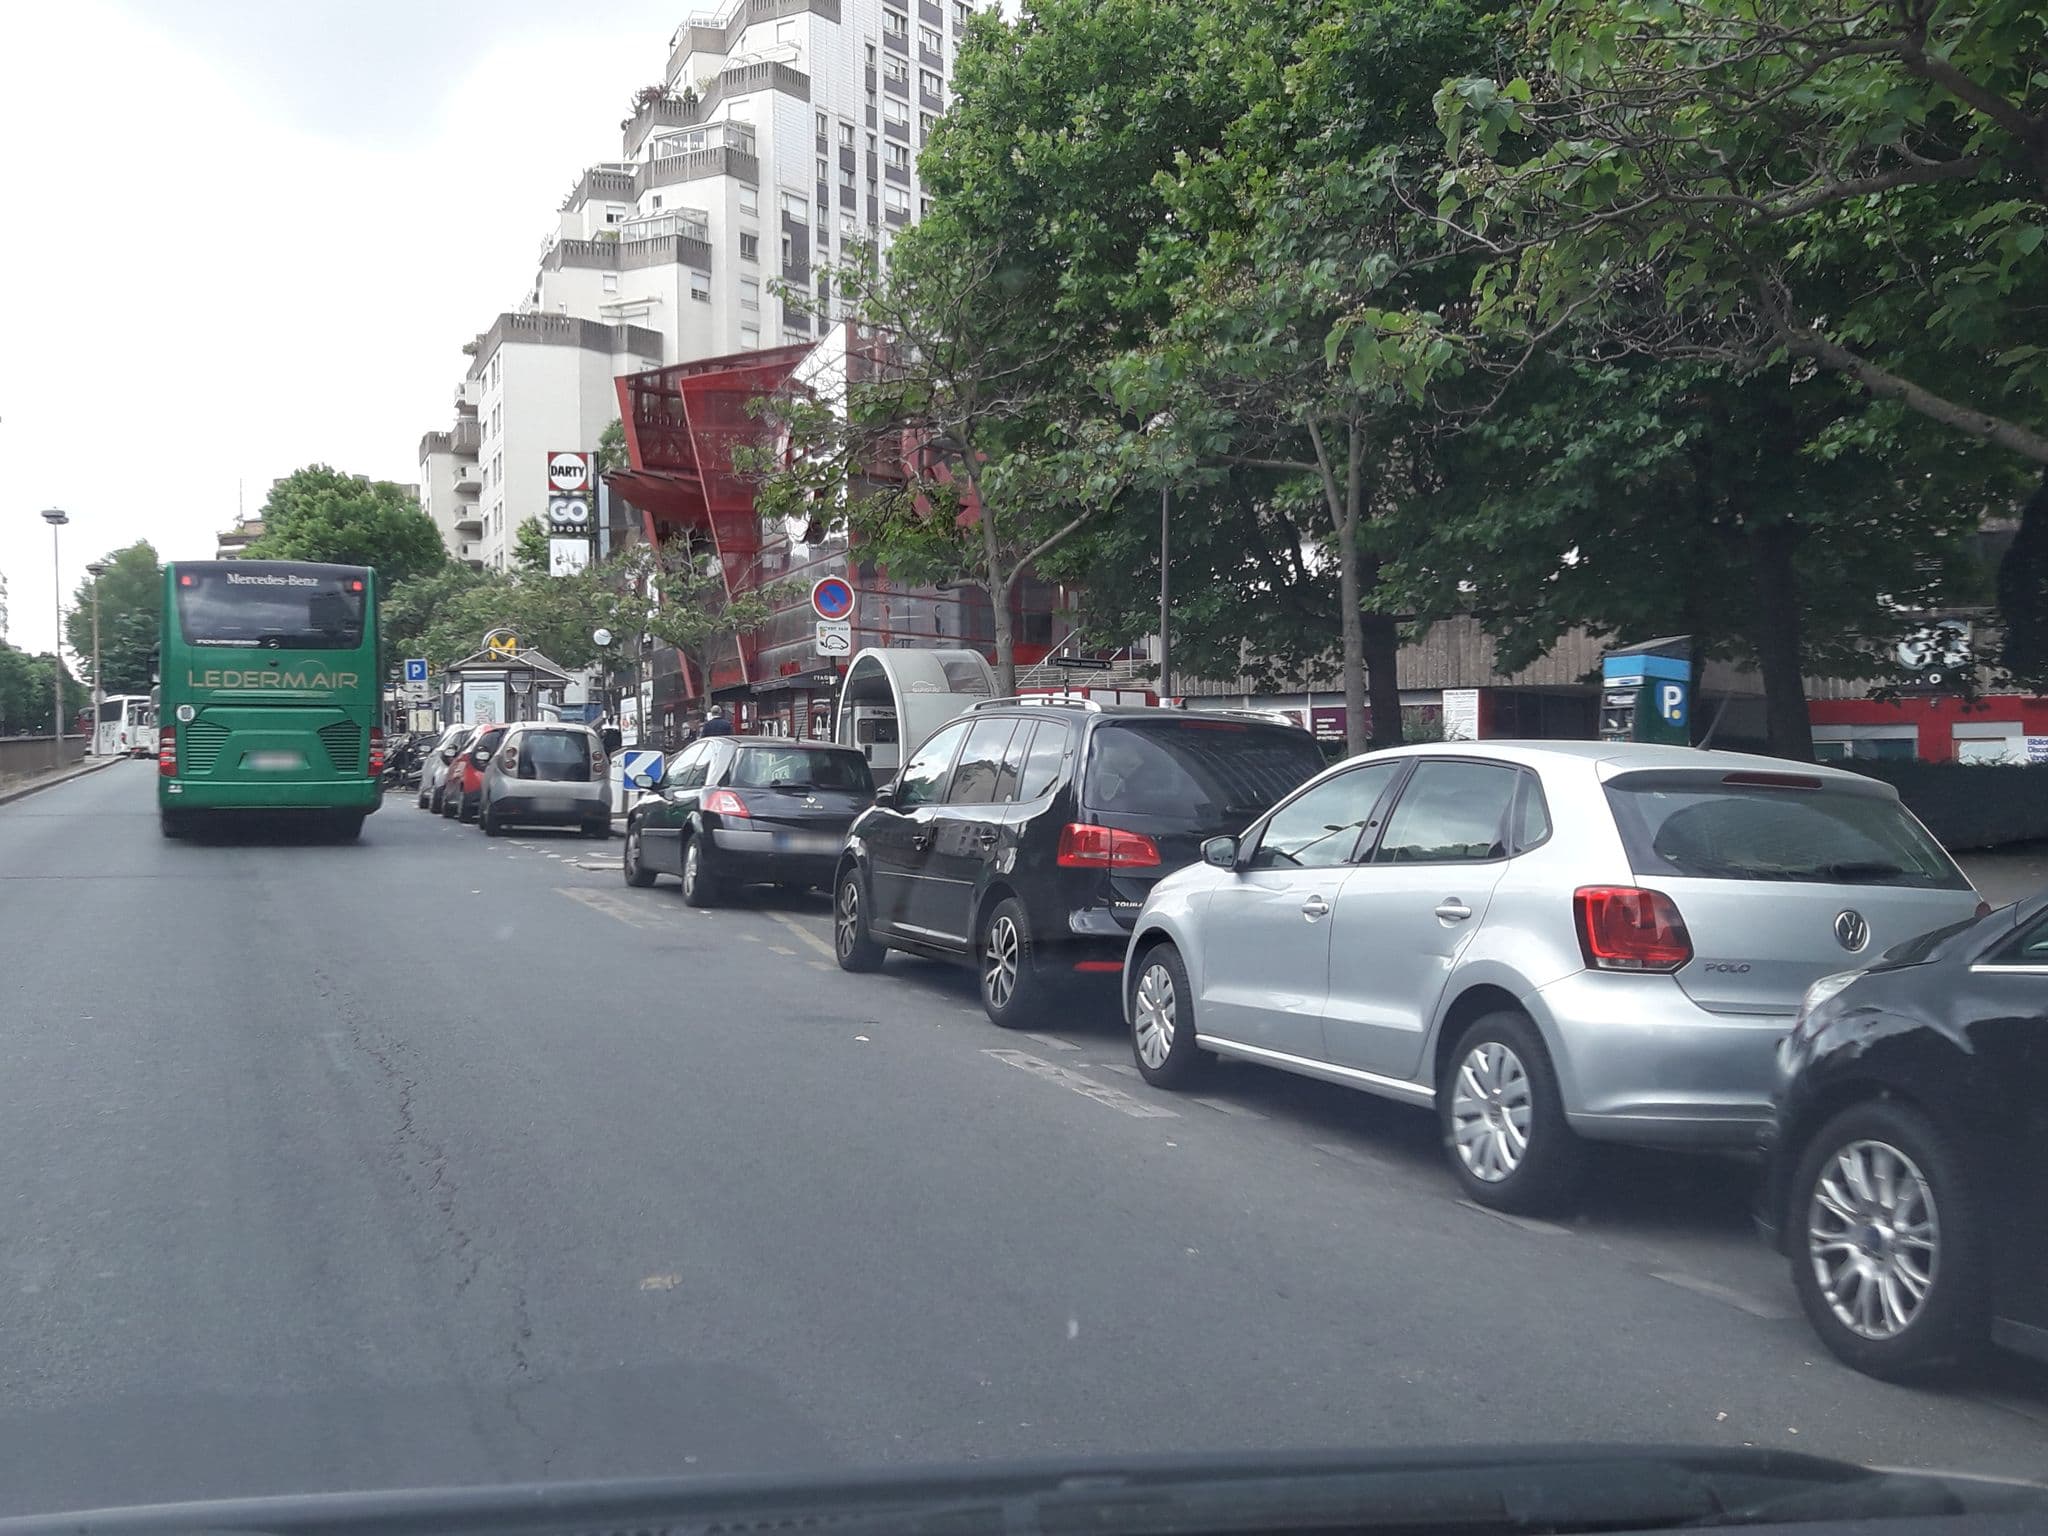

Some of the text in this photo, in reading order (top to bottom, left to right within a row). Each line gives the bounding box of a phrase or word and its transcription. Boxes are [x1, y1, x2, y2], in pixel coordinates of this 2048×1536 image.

[551, 465, 585, 477] DARTY
[550, 500, 588, 521] GO
[226, 573, 319, 586] Mercedes-Benz
[488, 634, 517, 662] M
[411, 664, 421, 678] P
[188, 670, 358, 689] LEDERMAIR
[1663, 685, 1682, 719] P
[2027, 738, 2048, 746] Biblio
[1705, 963, 1751, 973] POLO
